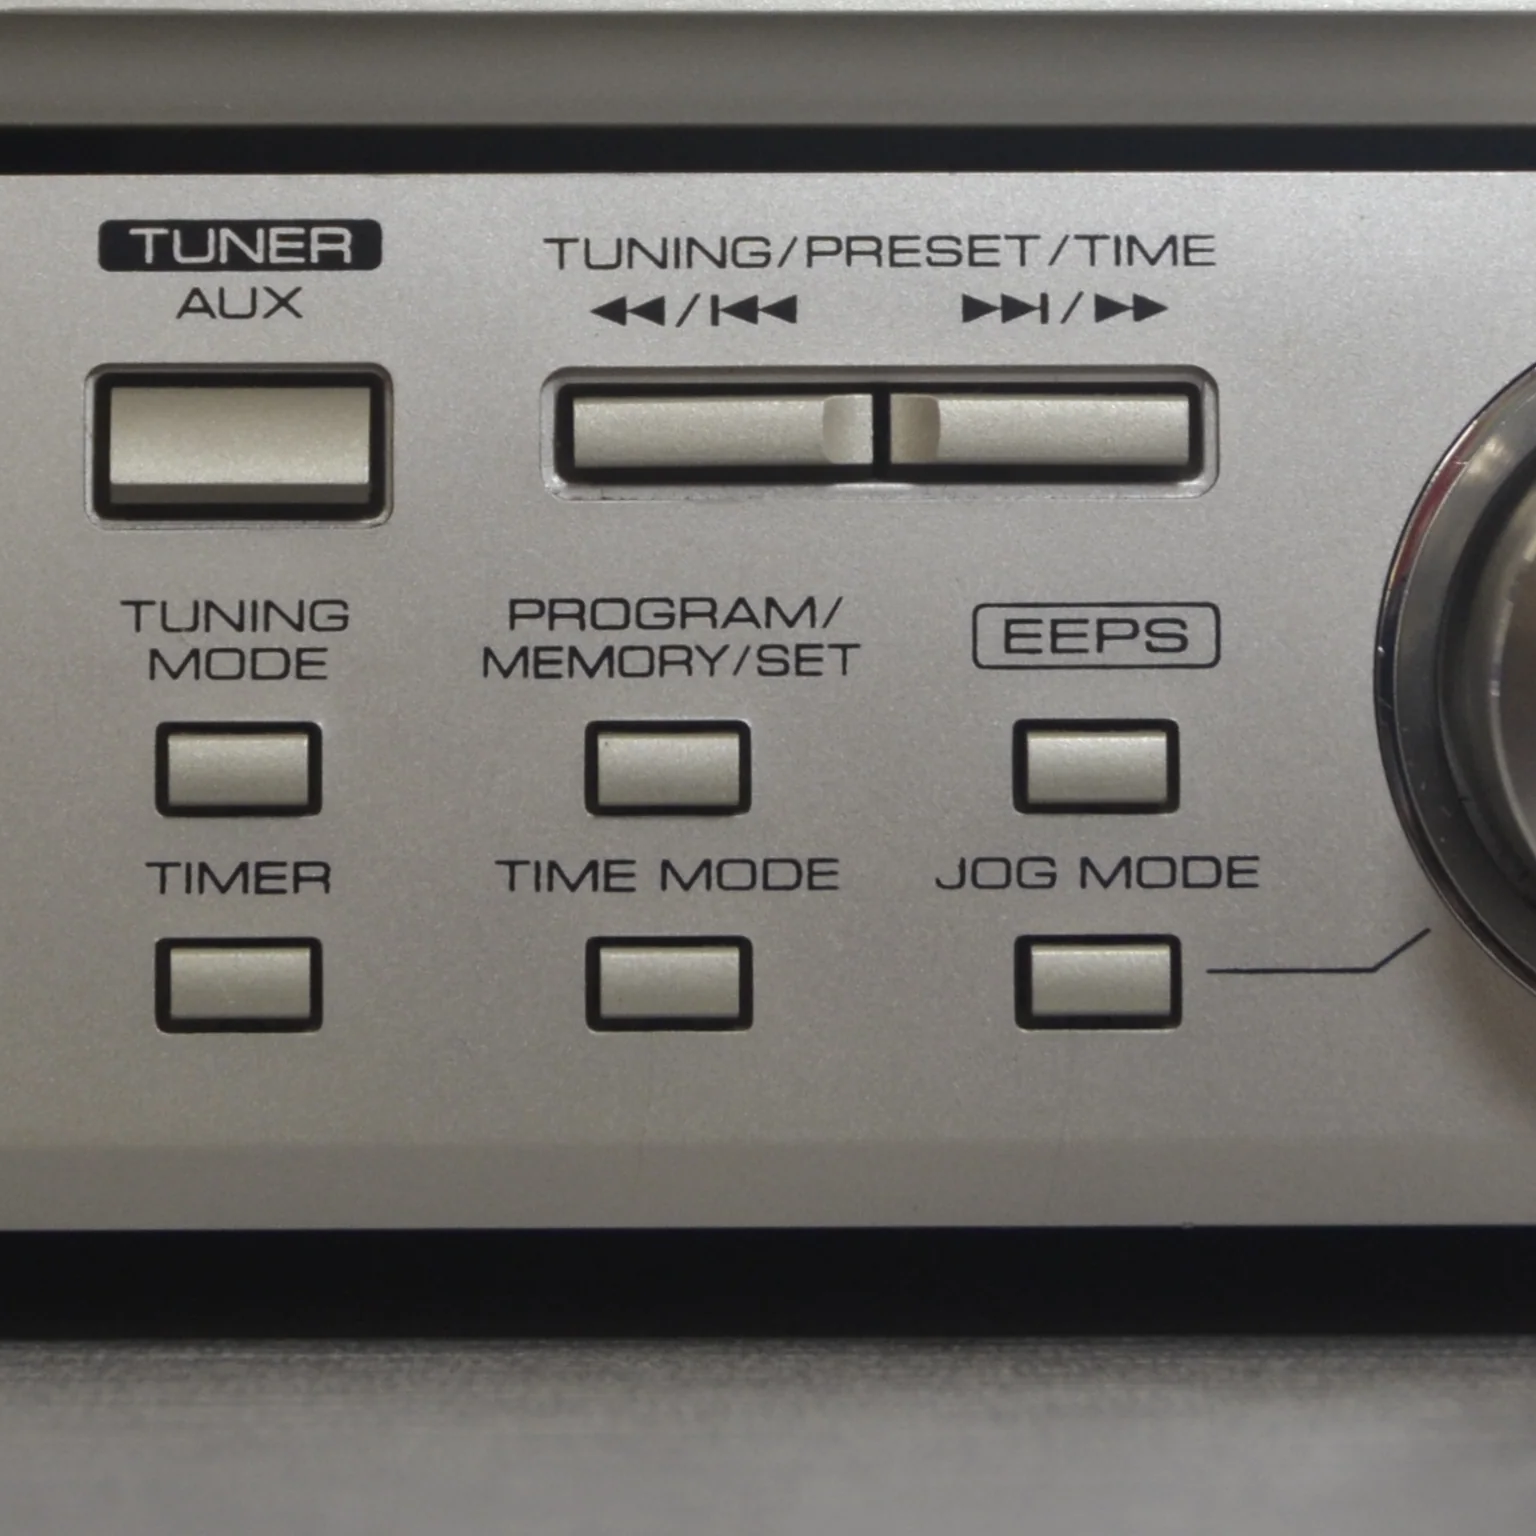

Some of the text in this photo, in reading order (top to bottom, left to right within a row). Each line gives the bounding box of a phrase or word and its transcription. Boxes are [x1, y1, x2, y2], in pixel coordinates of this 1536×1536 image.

[128, 226, 353, 265] TUNER
[543, 234, 1216, 271] TUNING/PRESET/TIME
[175, 286, 303, 320] AUX
[119, 598, 350, 634] TUNING
[508, 595, 843, 632] PROGRAM/
[1001, 616, 1191, 657] EEPS
[148, 646, 329, 681] MODE
[482, 642, 861, 680] MEMORY/SET
[145, 860, 332, 896] TIMER
[494, 857, 839, 894] TIME MODE
[934, 855, 1260, 891] JOG MODE
